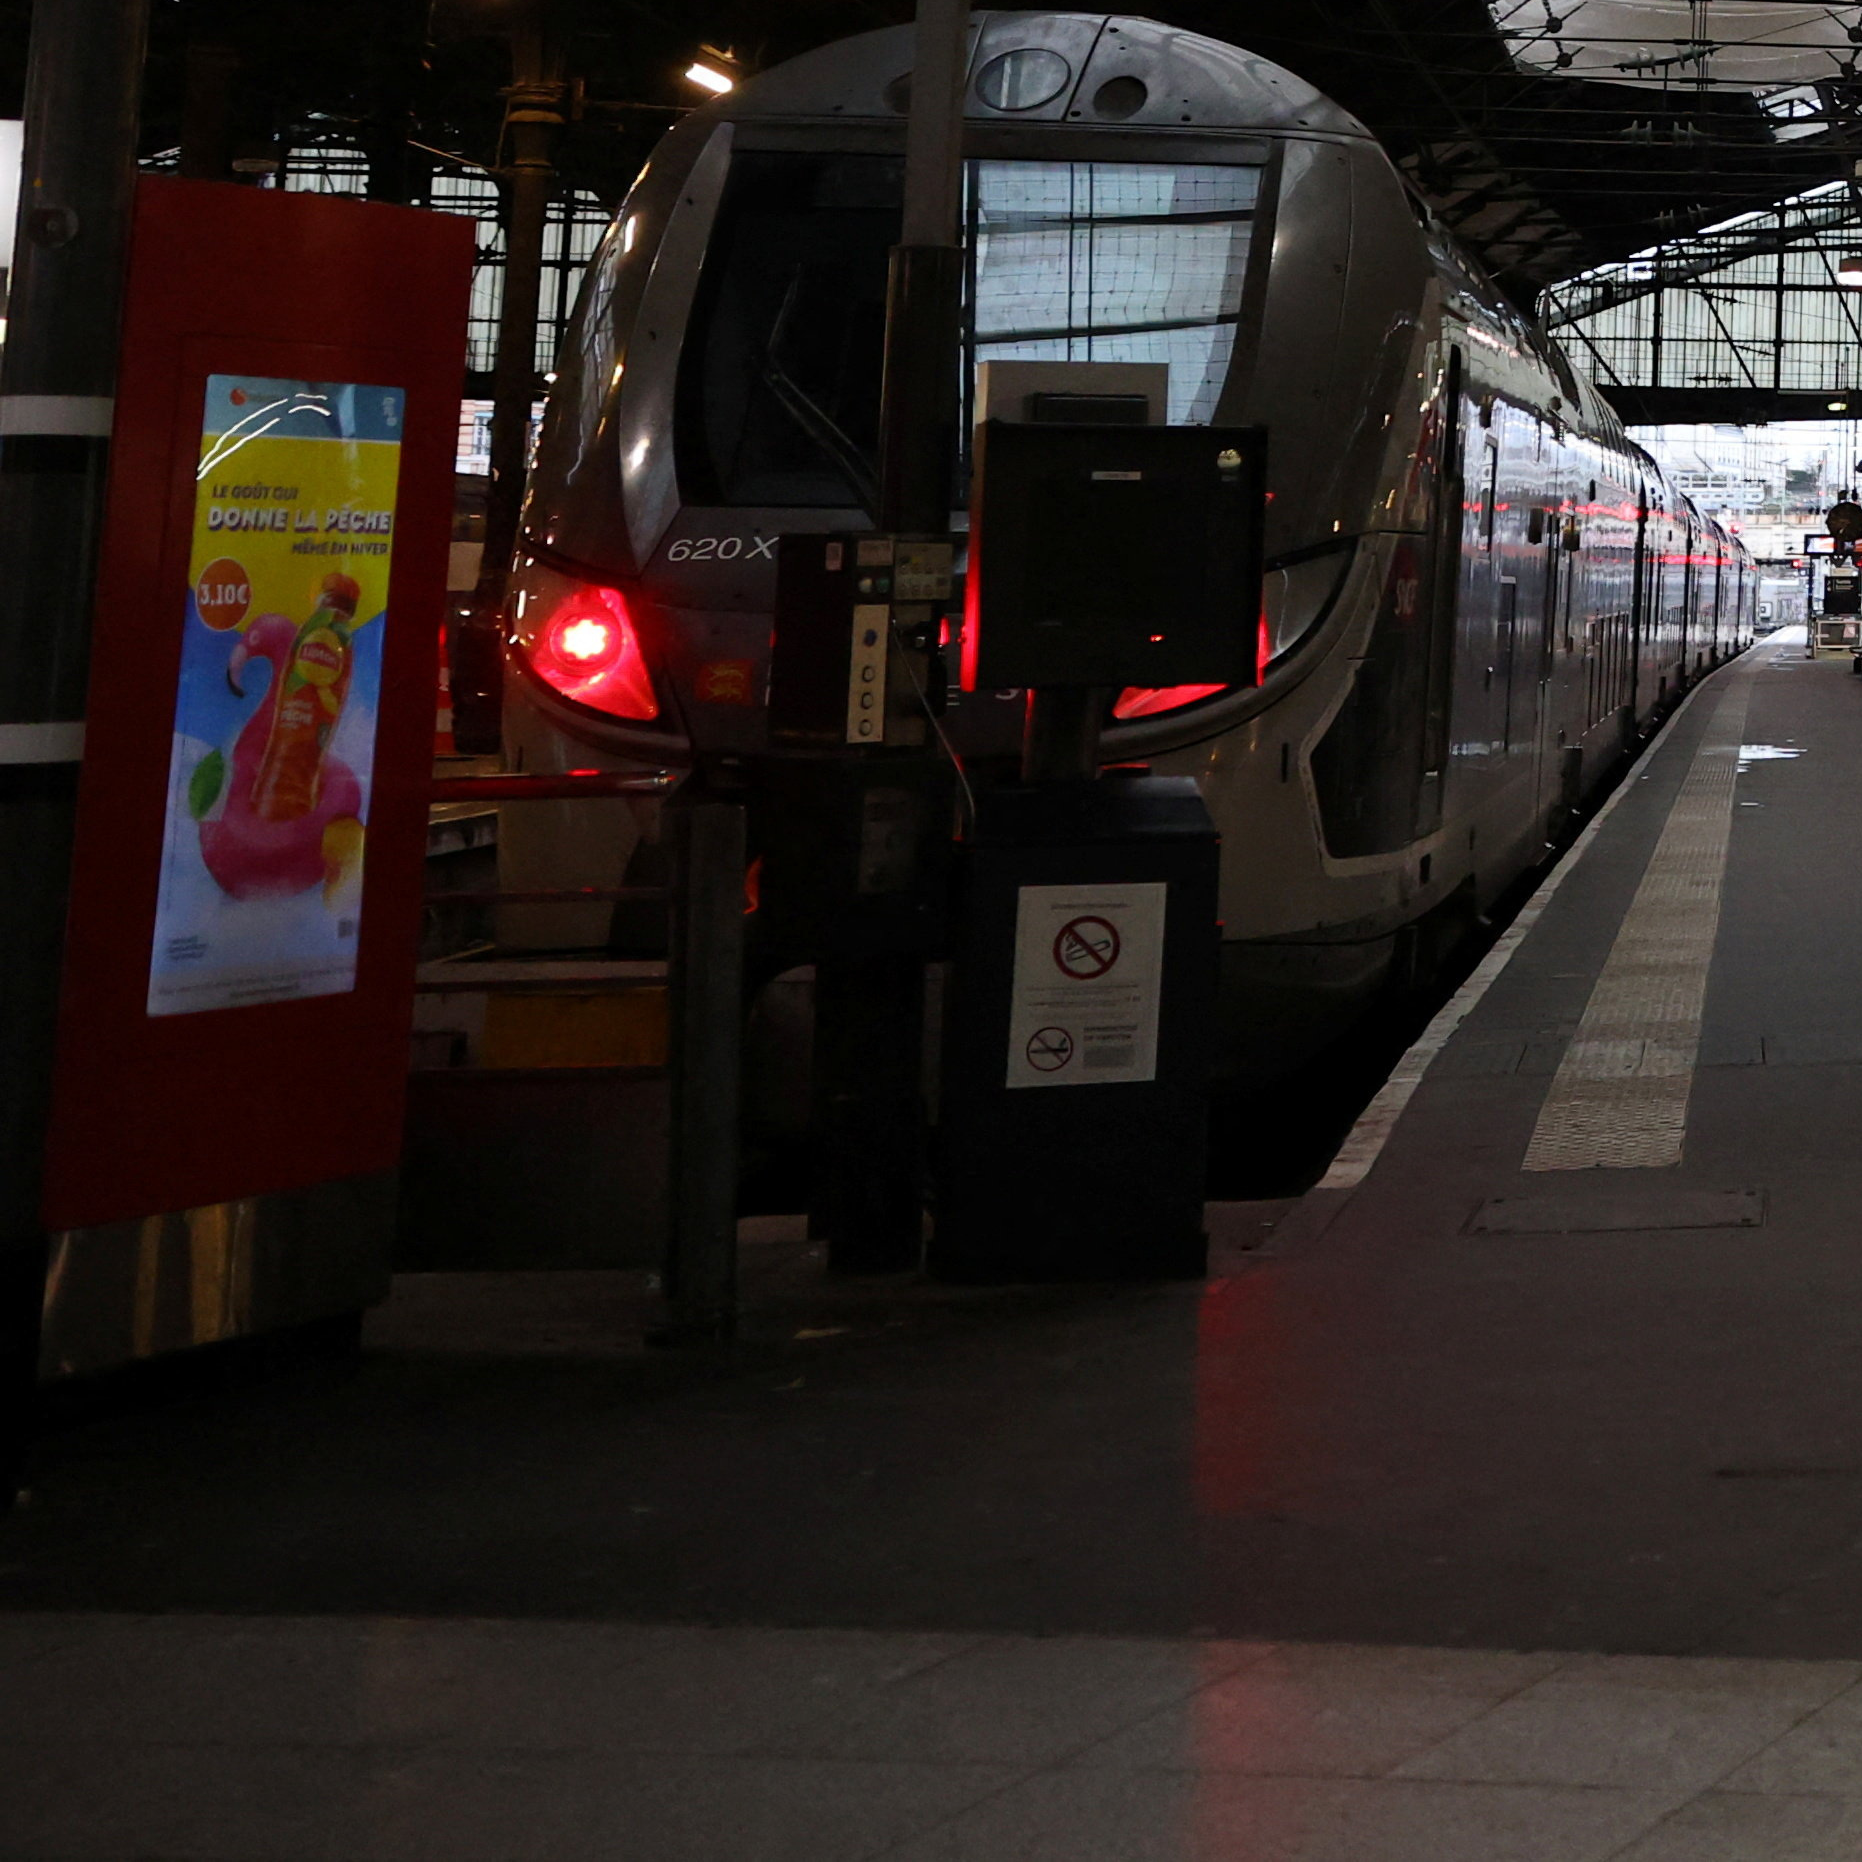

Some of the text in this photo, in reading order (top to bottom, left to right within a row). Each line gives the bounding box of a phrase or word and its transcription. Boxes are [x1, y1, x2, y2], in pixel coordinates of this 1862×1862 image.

[212, 484, 227, 499] LE
[231, 482, 269, 500] GOÛT
[207, 502, 392, 534] DONNE LA PÊCHE
[292, 537, 388, 556] MÊME EN HIVER
[199, 583, 250, 607] 3,10€
